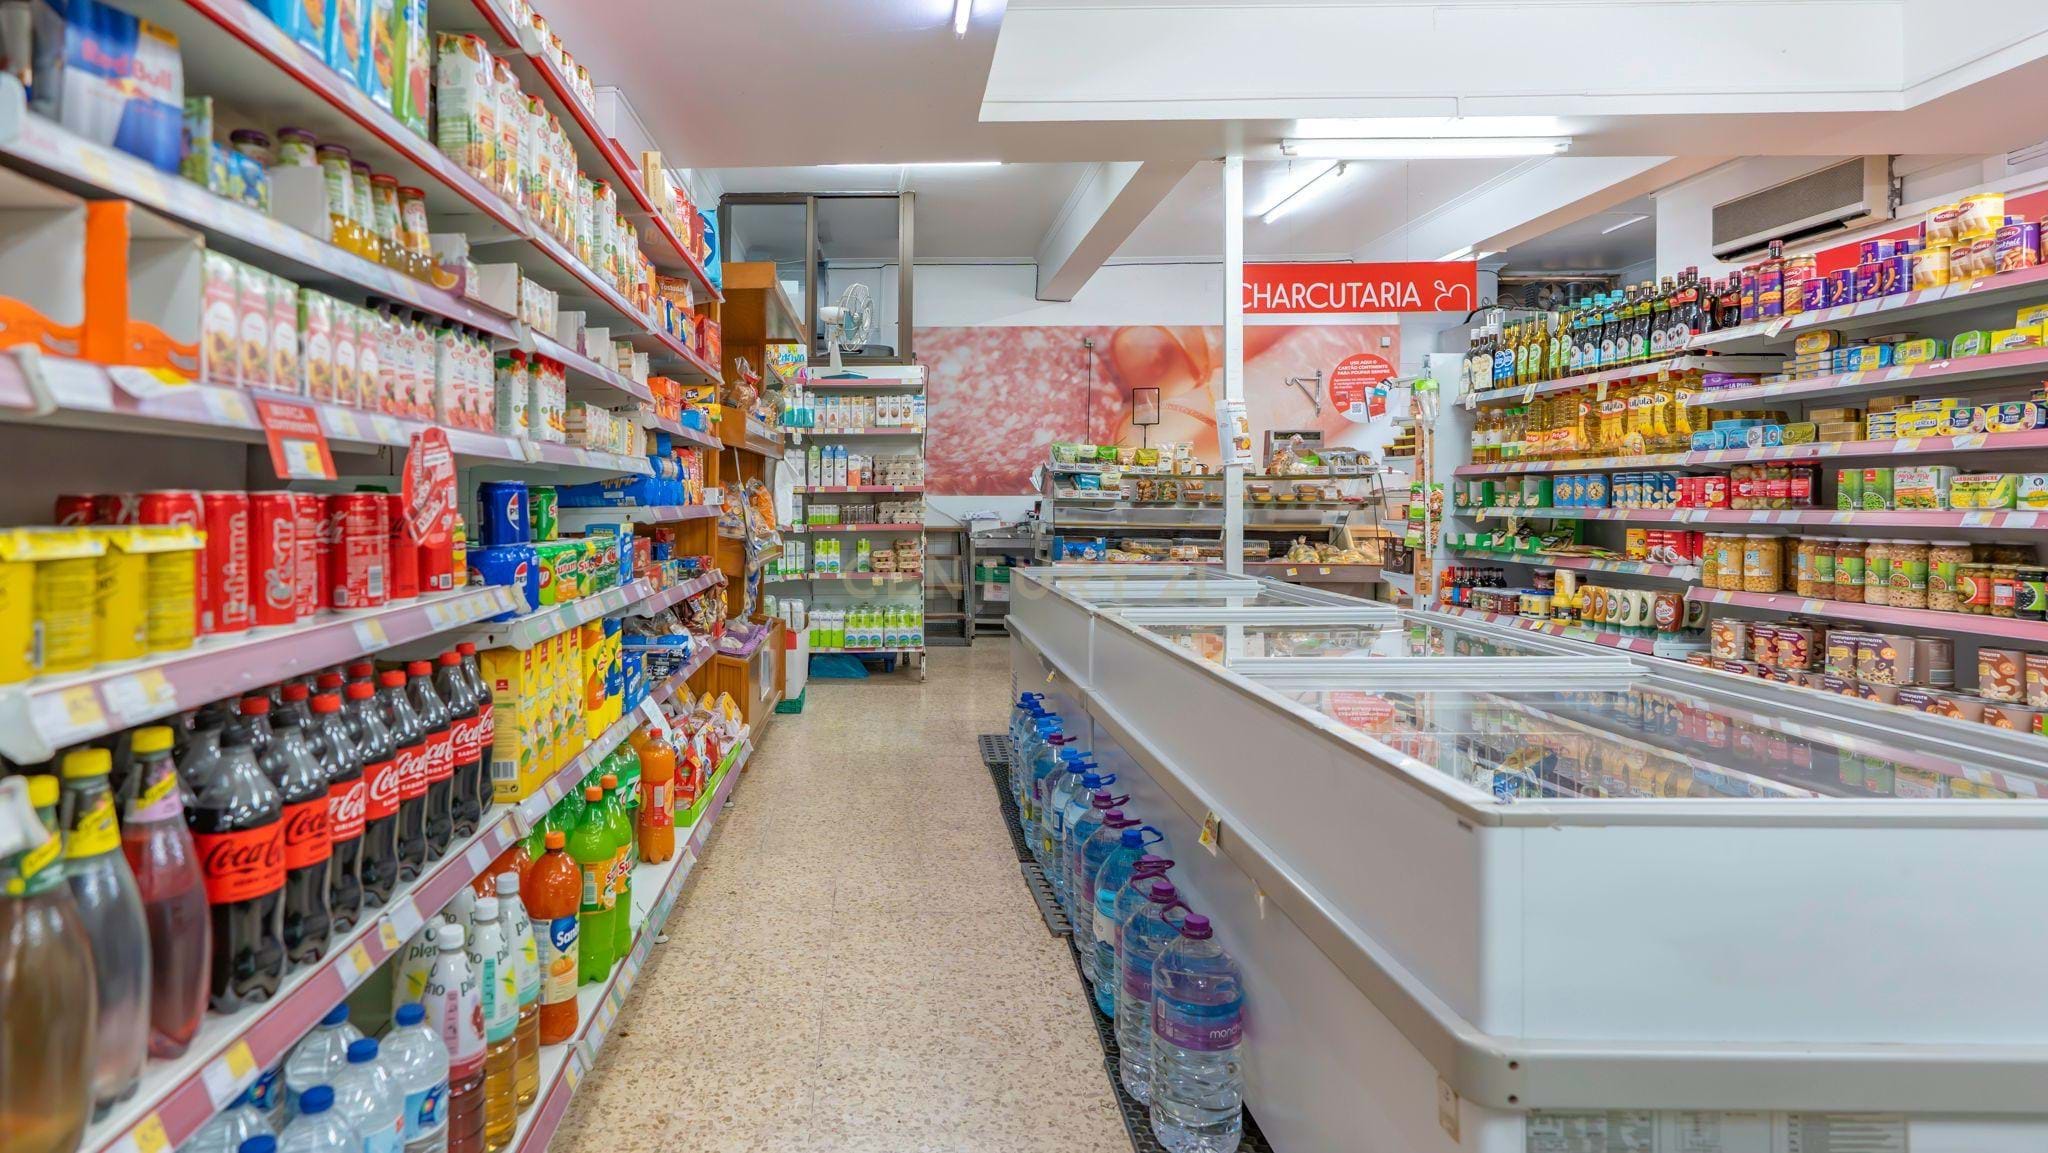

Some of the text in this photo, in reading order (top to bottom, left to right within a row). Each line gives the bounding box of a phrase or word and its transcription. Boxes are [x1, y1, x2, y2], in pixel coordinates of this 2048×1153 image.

[81, 38, 173, 93] Red Bull
[1241, 282, 1422, 309] CHARCUTARIA
